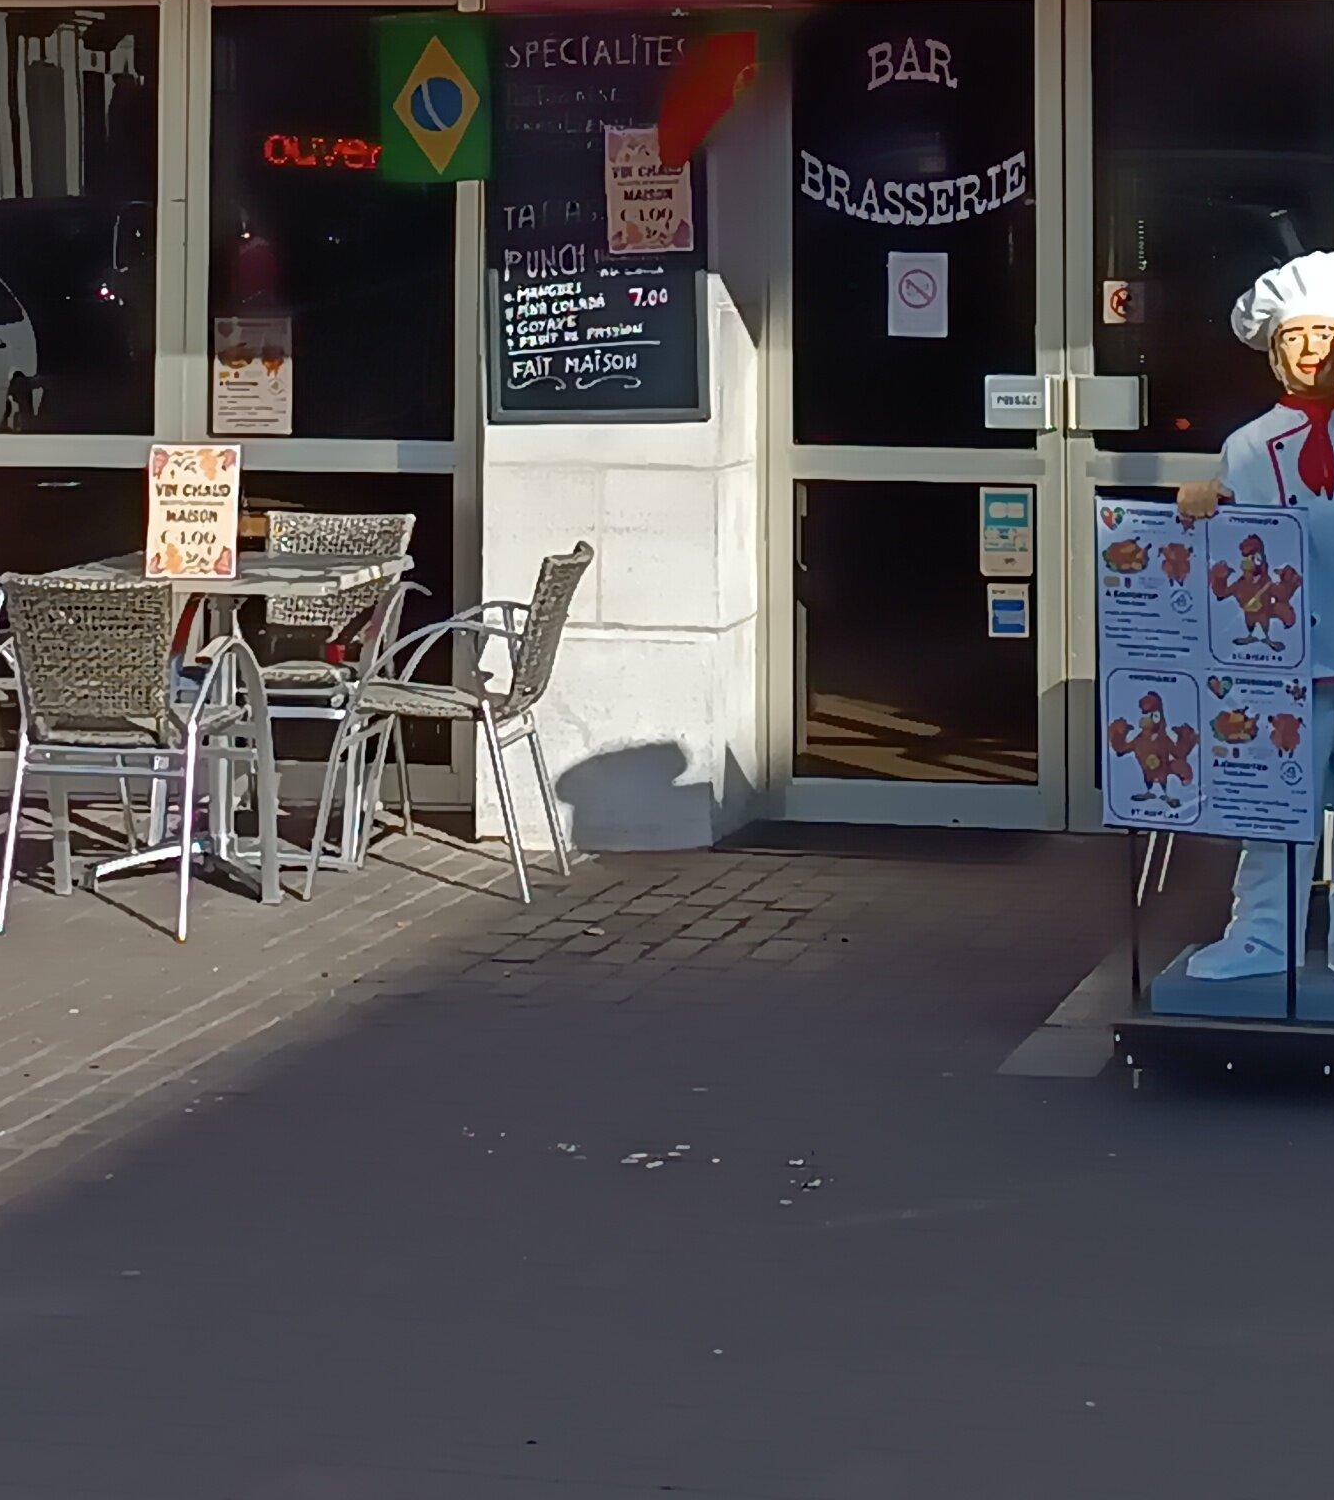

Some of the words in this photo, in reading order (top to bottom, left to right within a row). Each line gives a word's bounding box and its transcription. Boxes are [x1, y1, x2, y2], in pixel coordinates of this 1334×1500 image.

[867, 37, 958, 90] BAR
[800, 150, 1026, 226] BRASSERIE
[628, 287, 668, 307] 7.00
[166, 509, 218, 523] MAISON
